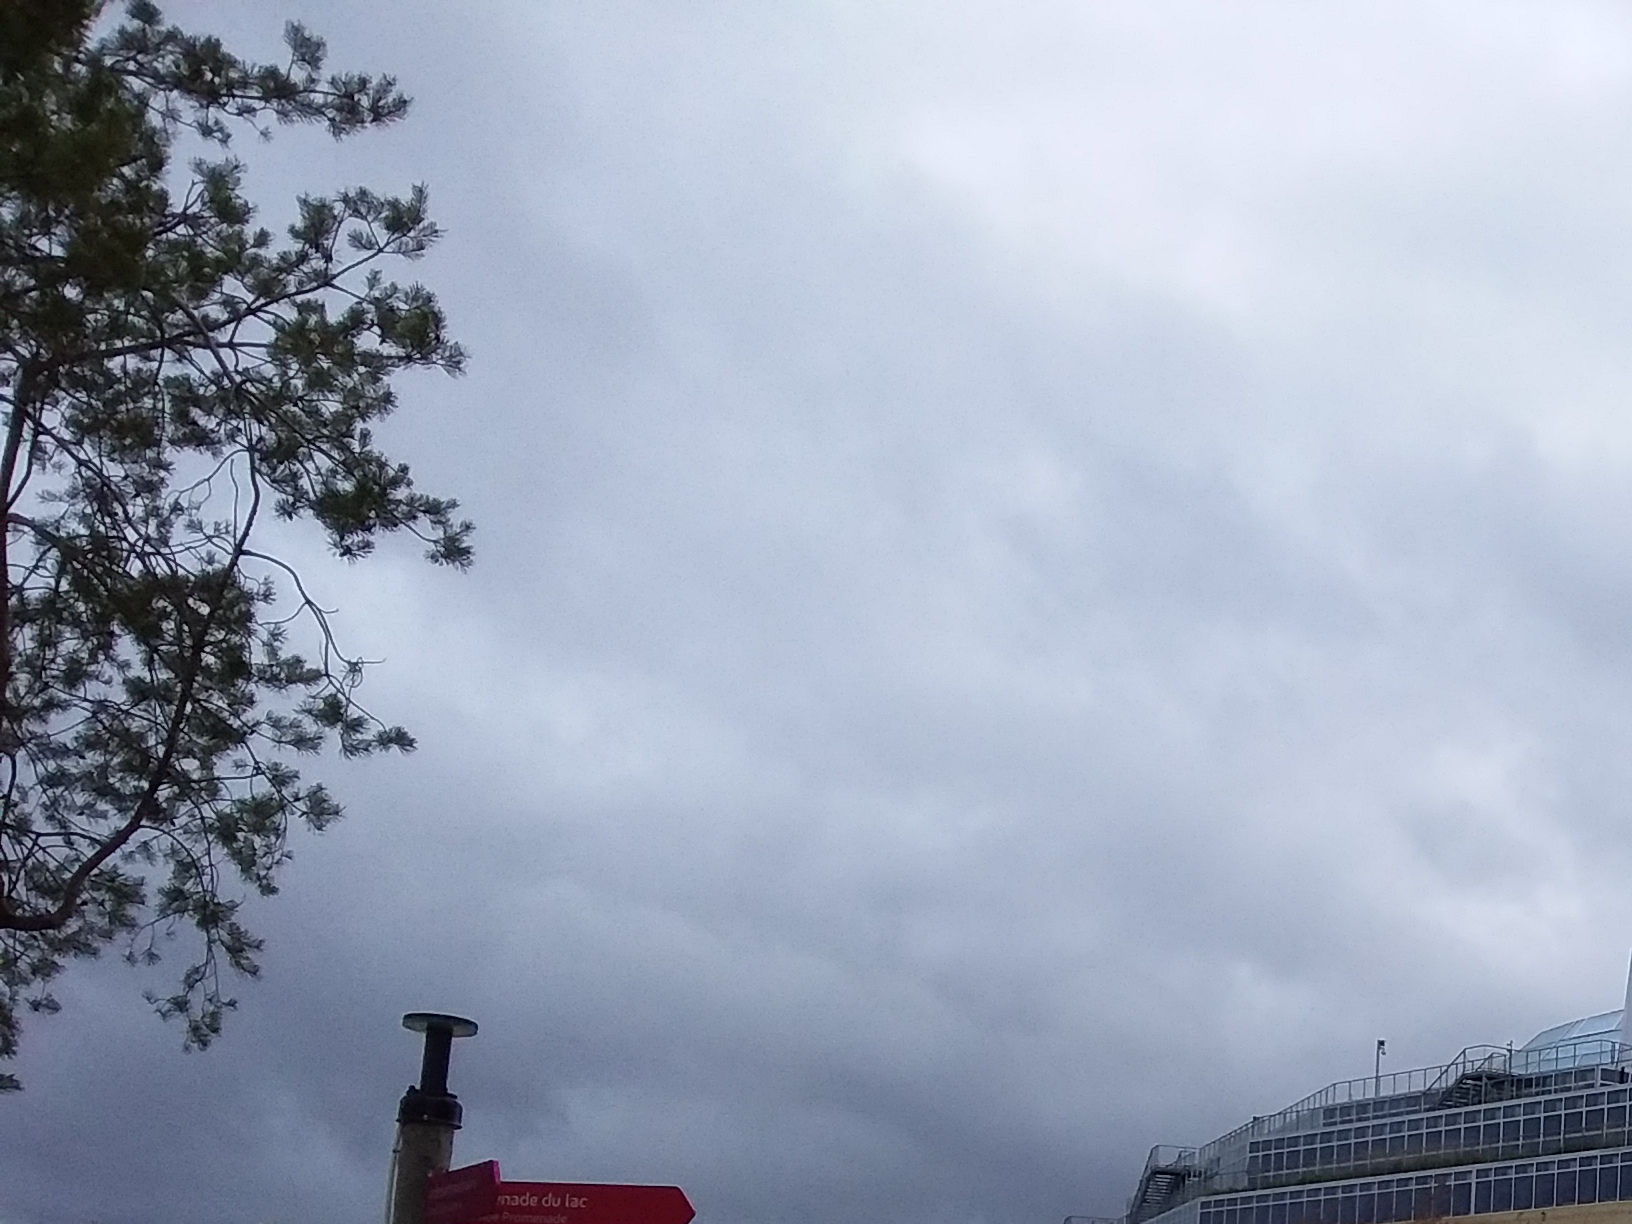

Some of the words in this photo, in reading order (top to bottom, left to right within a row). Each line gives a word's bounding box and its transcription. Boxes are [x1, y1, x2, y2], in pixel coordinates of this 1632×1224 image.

[496, 1191, 538, 1207] nade
[541, 1192, 561, 1208] du
[565, 1193, 589, 1209] lac
[502, 1211, 568, 1224] Promenade
